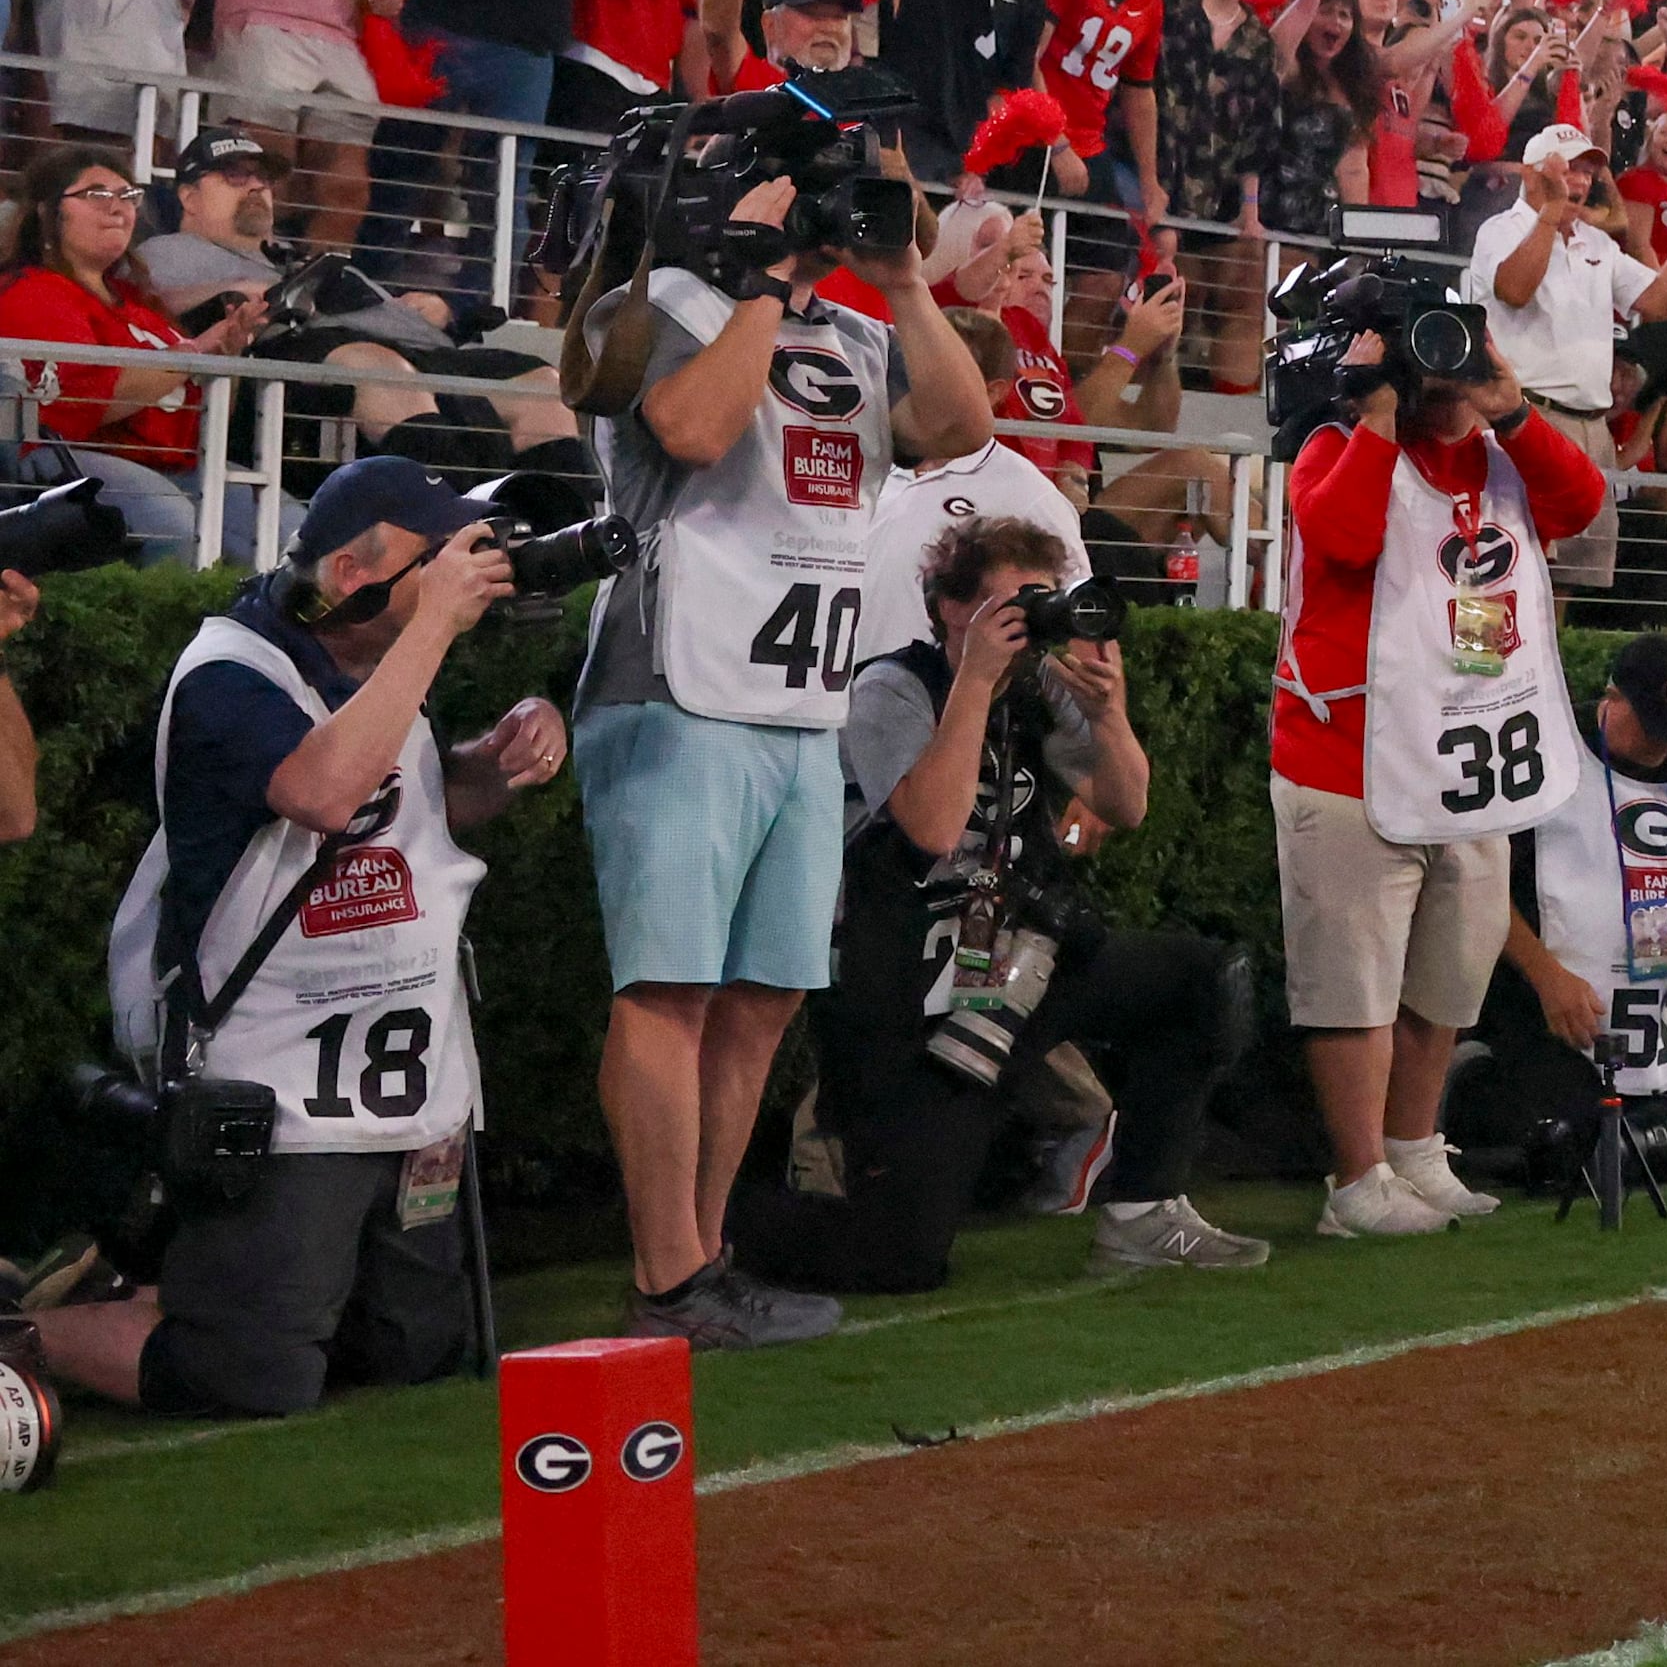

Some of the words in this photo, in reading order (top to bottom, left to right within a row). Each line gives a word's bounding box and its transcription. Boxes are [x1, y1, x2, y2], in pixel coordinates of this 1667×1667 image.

[811, 437, 852, 461] FARM
[794, 457, 851, 481] BUREAU
[750, 582, 862, 693] 40
[1437, 710, 1545, 814] 38
[336, 858, 396, 879] FARM
[309, 870, 402, 906] BUREAU
[331, 896, 407, 922] INSURANCE
[302, 1006, 432, 1119] 18
[6, 1385, 25, 1409] AP
[18, 1416, 31, 1448] AP
